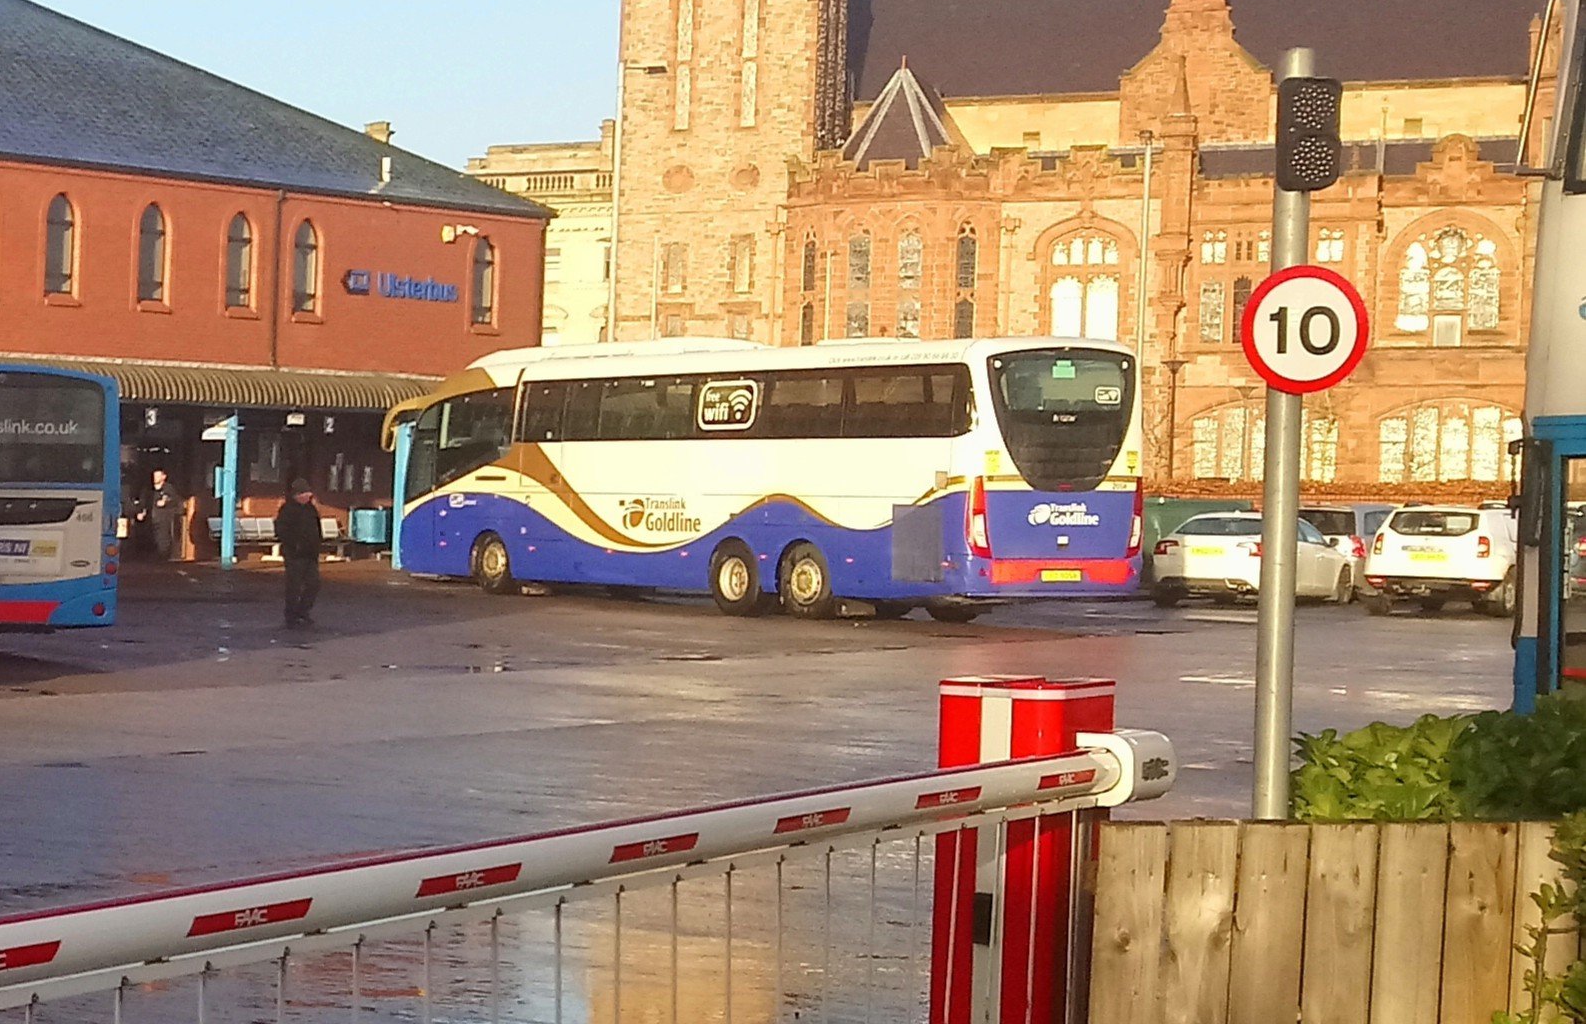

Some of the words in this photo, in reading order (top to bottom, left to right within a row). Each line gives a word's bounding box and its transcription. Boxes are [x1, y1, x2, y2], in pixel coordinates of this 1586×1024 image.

[378, 272, 458, 302] Ulsterbus
[1270, 306, 1340, 355] 10
[705, 390, 721, 402] free
[145, 410, 157, 427] 3
[703, 403, 728, 421] wifi
[324, 416, 335, 433] 2
[645, 497, 686, 509] Translink
[1050, 502, 1087, 513] Translink
[645, 512, 701, 532] Goldline
[1050, 512, 1099, 526] Goldline
[15, 542, 27, 553] NI
[455, 869, 485, 889] FAAC
[234, 907, 268, 926] FAAC
